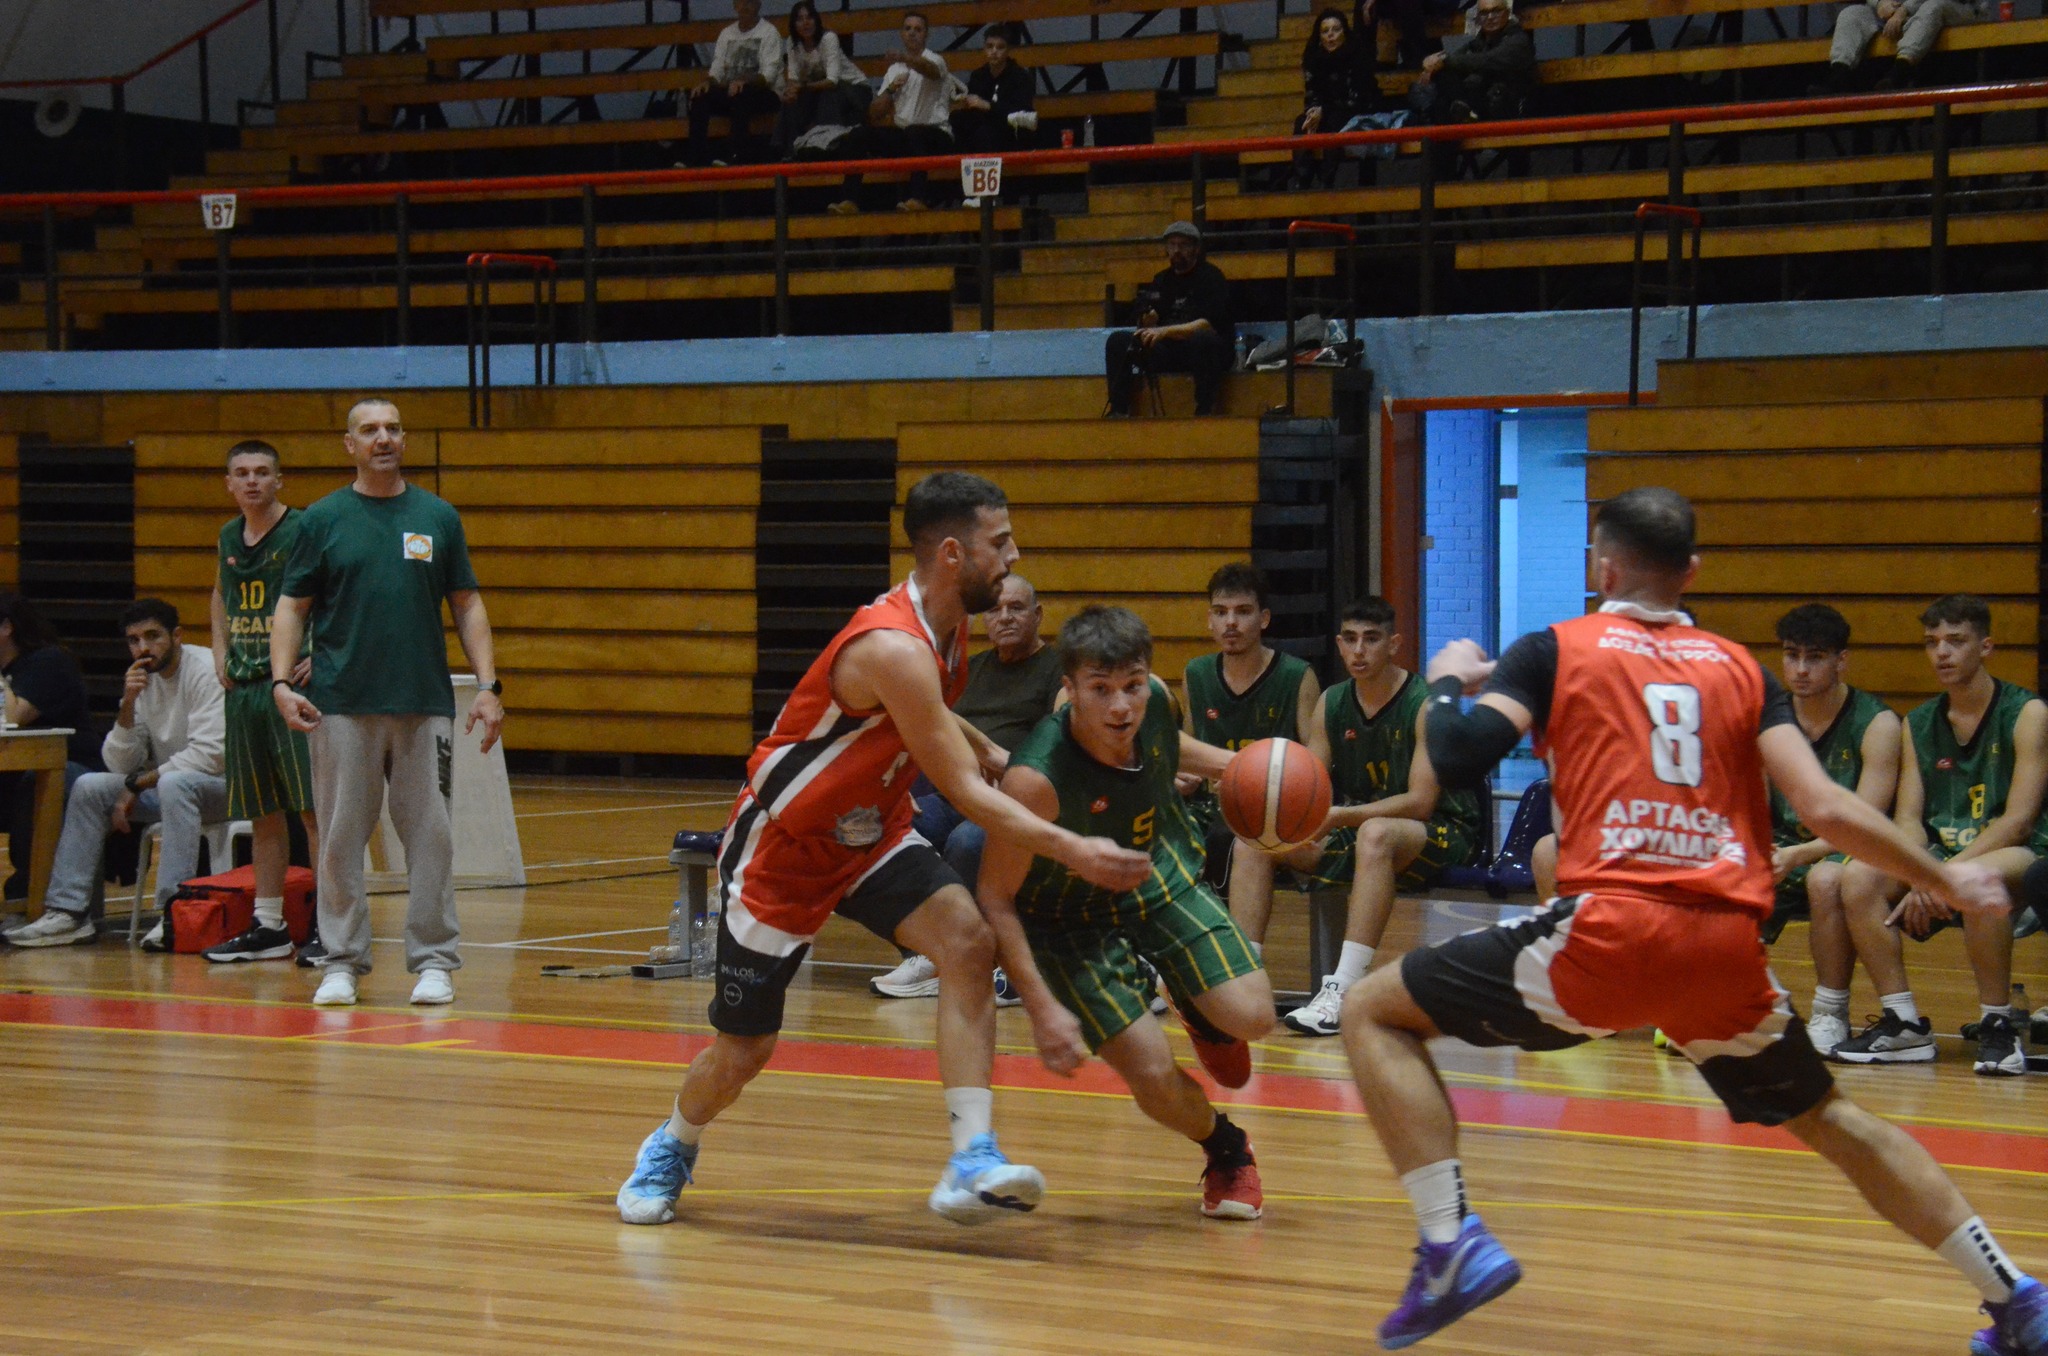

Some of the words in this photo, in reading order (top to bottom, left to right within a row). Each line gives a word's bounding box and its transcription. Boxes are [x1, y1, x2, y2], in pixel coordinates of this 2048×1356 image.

[240, 580, 265, 610] 10
[1643, 682, 1702, 788] 8
[436, 735, 452, 798] NIKE
[1968, 783, 1986, 820] 8
[1132, 805, 1156, 846] 5
